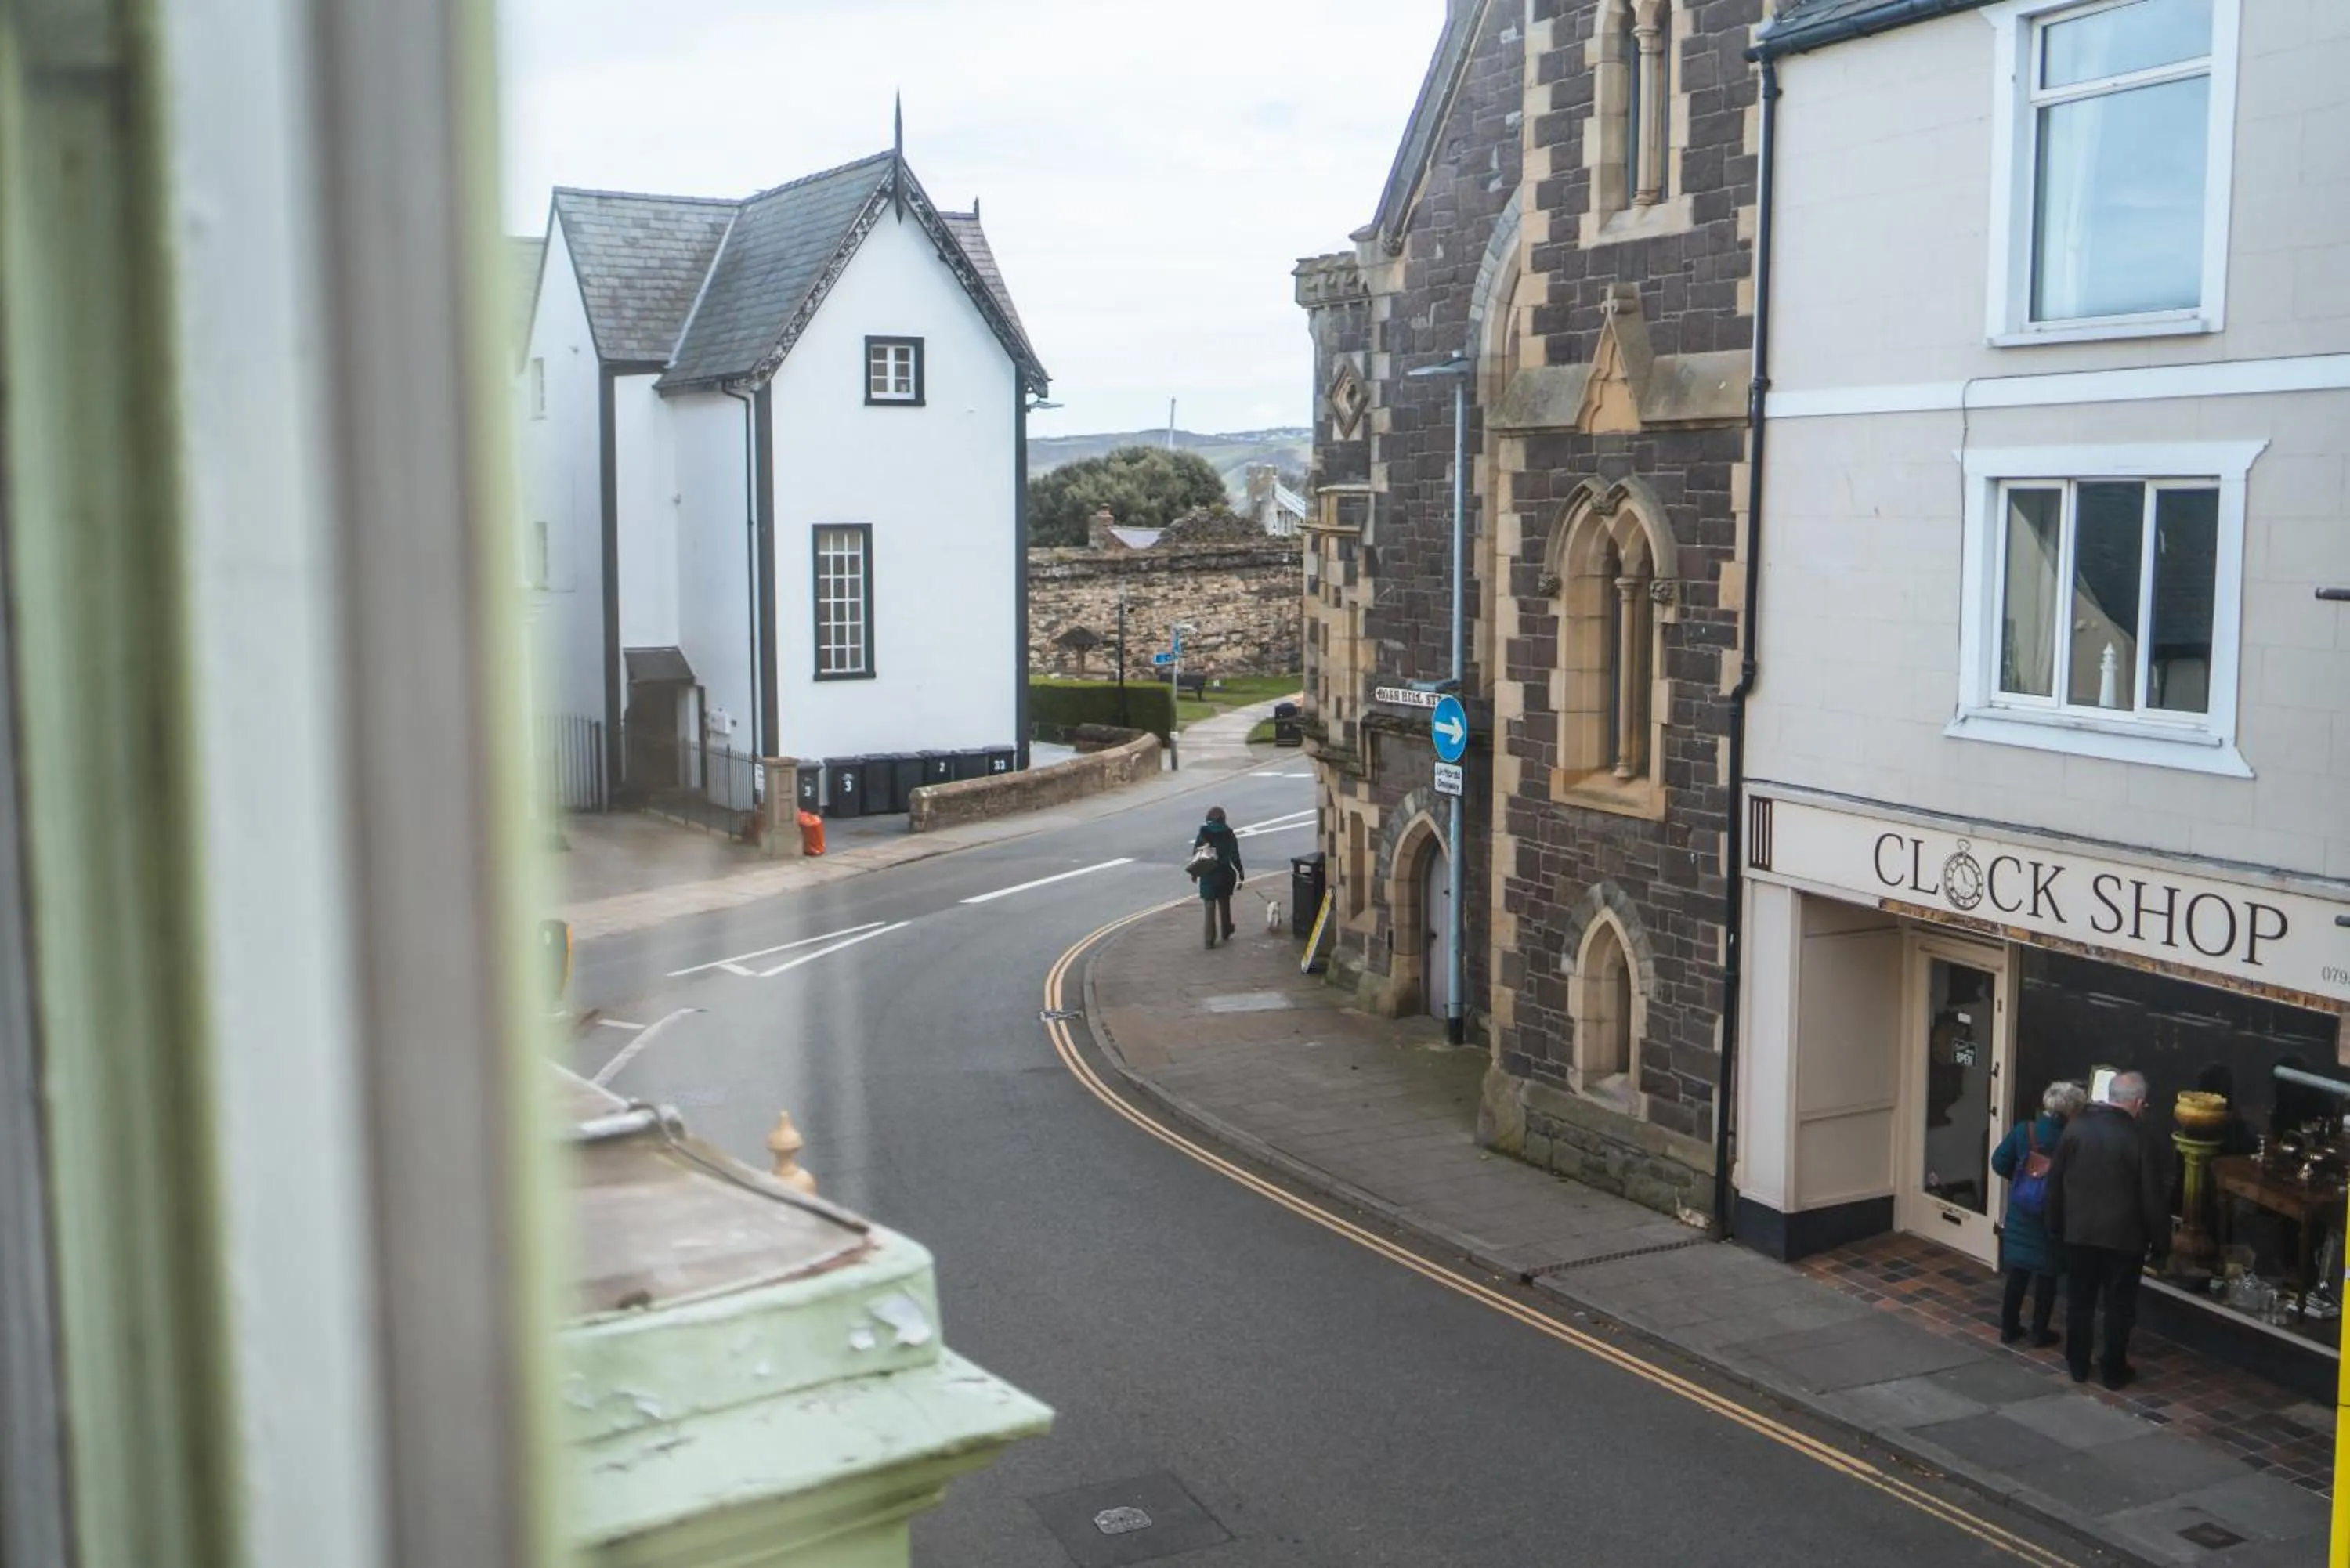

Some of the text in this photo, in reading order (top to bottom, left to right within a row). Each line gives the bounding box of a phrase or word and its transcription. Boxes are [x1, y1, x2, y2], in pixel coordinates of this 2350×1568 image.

[1875, 833, 2288, 965] CLOCK SHOP
[2321, 966, 2350, 985] 079
